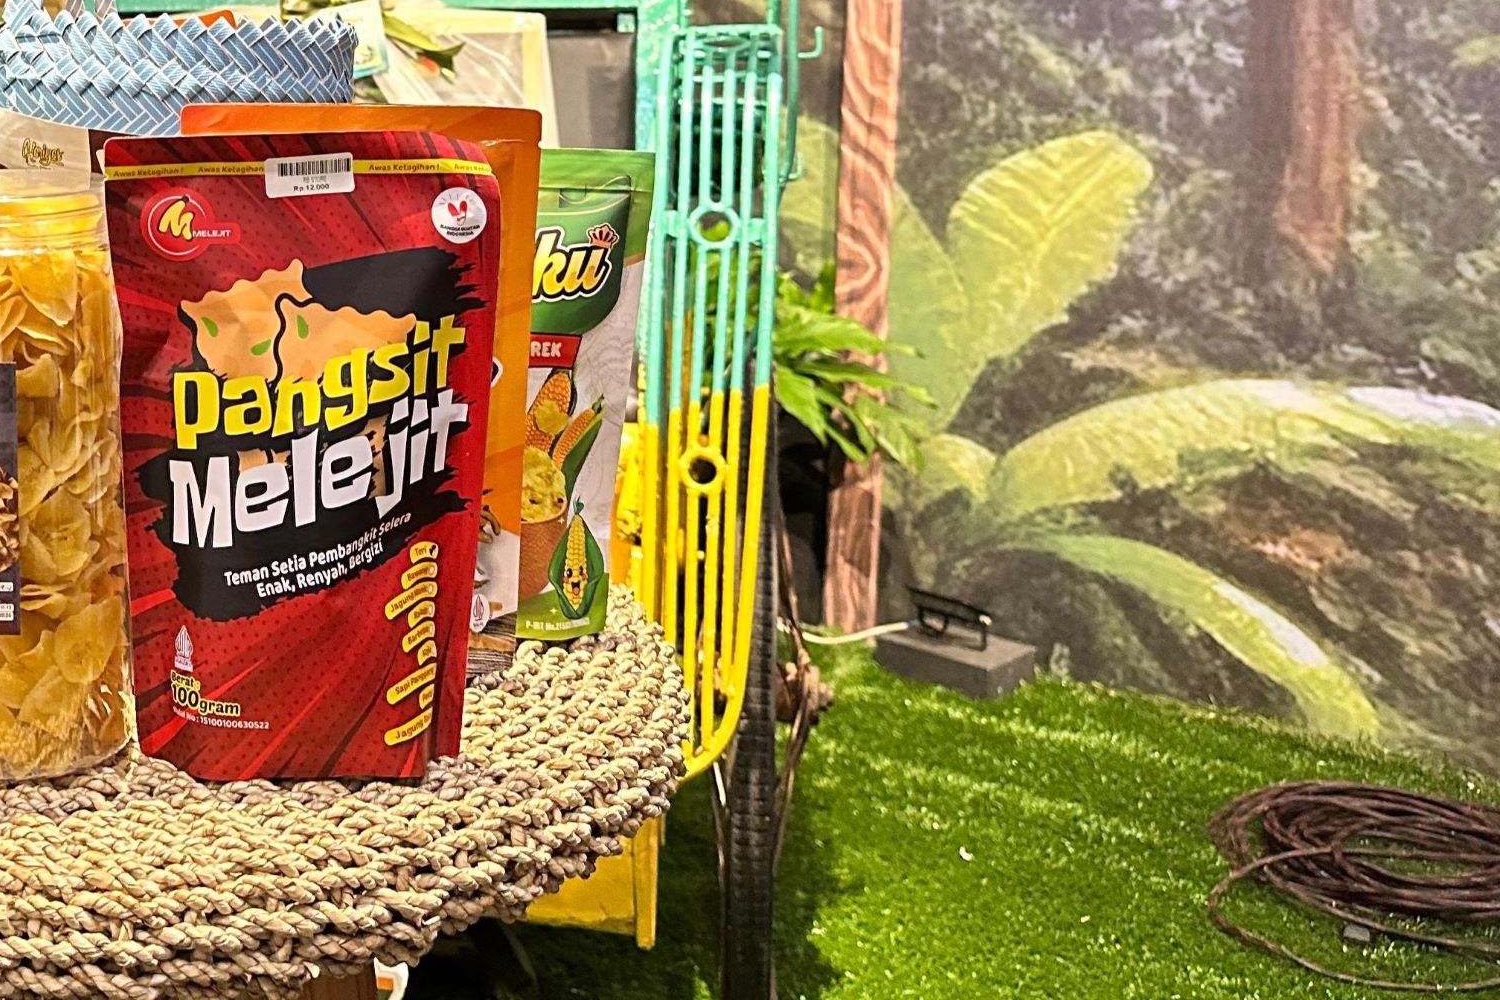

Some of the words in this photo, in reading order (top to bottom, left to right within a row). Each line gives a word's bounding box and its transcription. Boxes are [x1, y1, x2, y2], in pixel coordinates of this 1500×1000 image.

[532, 228, 607, 297] ku
[531, 340, 562, 358] REK
[169, 388, 468, 548] Melejit
[224, 566, 269, 587] Teman
[271, 554, 307, 577] Setia
[308, 526, 377, 567] Pembangkit
[378, 512, 412, 536] Selera
[256, 576, 296, 598] Enak,
[298, 562, 348, 588] Renyah,
[349, 537, 384, 570] Bergizi
